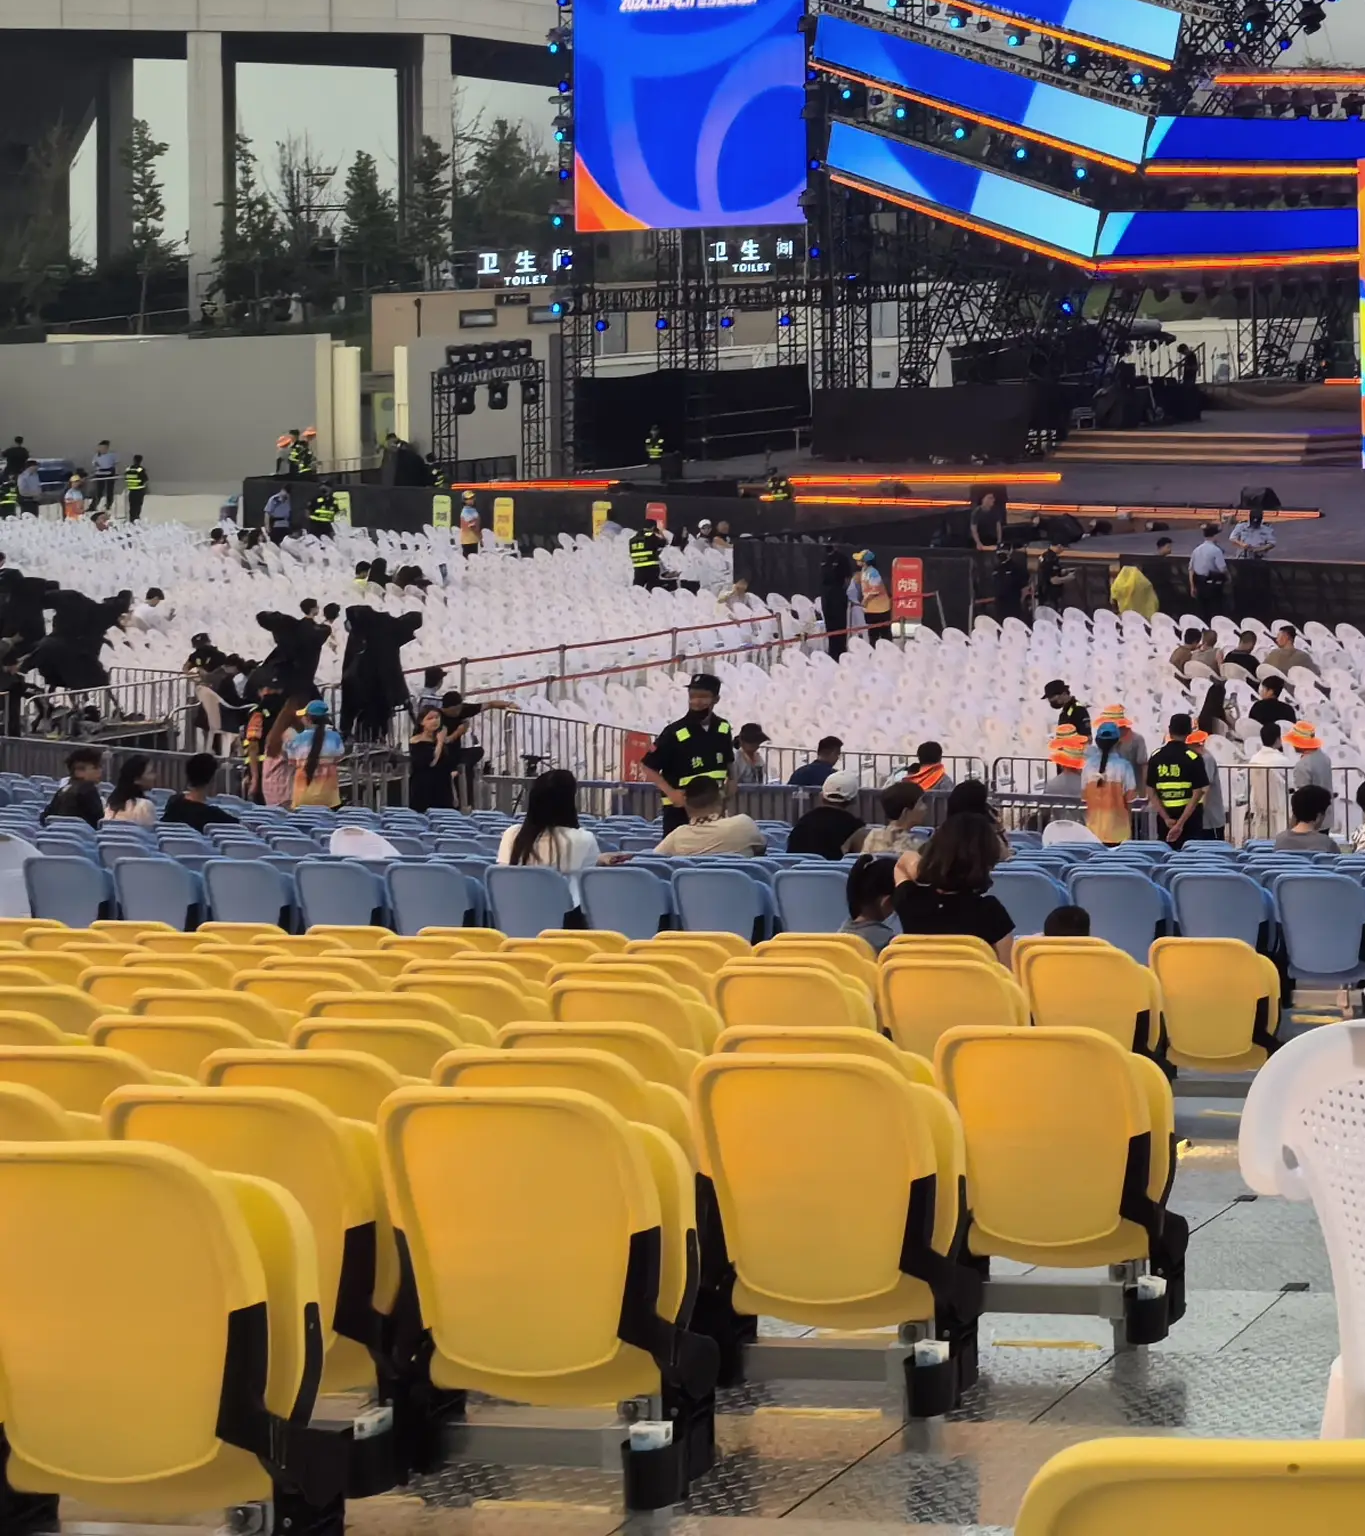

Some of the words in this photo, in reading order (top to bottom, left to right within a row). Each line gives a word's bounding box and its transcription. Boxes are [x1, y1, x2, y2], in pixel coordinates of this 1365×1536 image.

[708, 237, 793, 262] 卫生间
[732, 262, 771, 273] TOILET
[504, 274, 548, 286] TOILET
